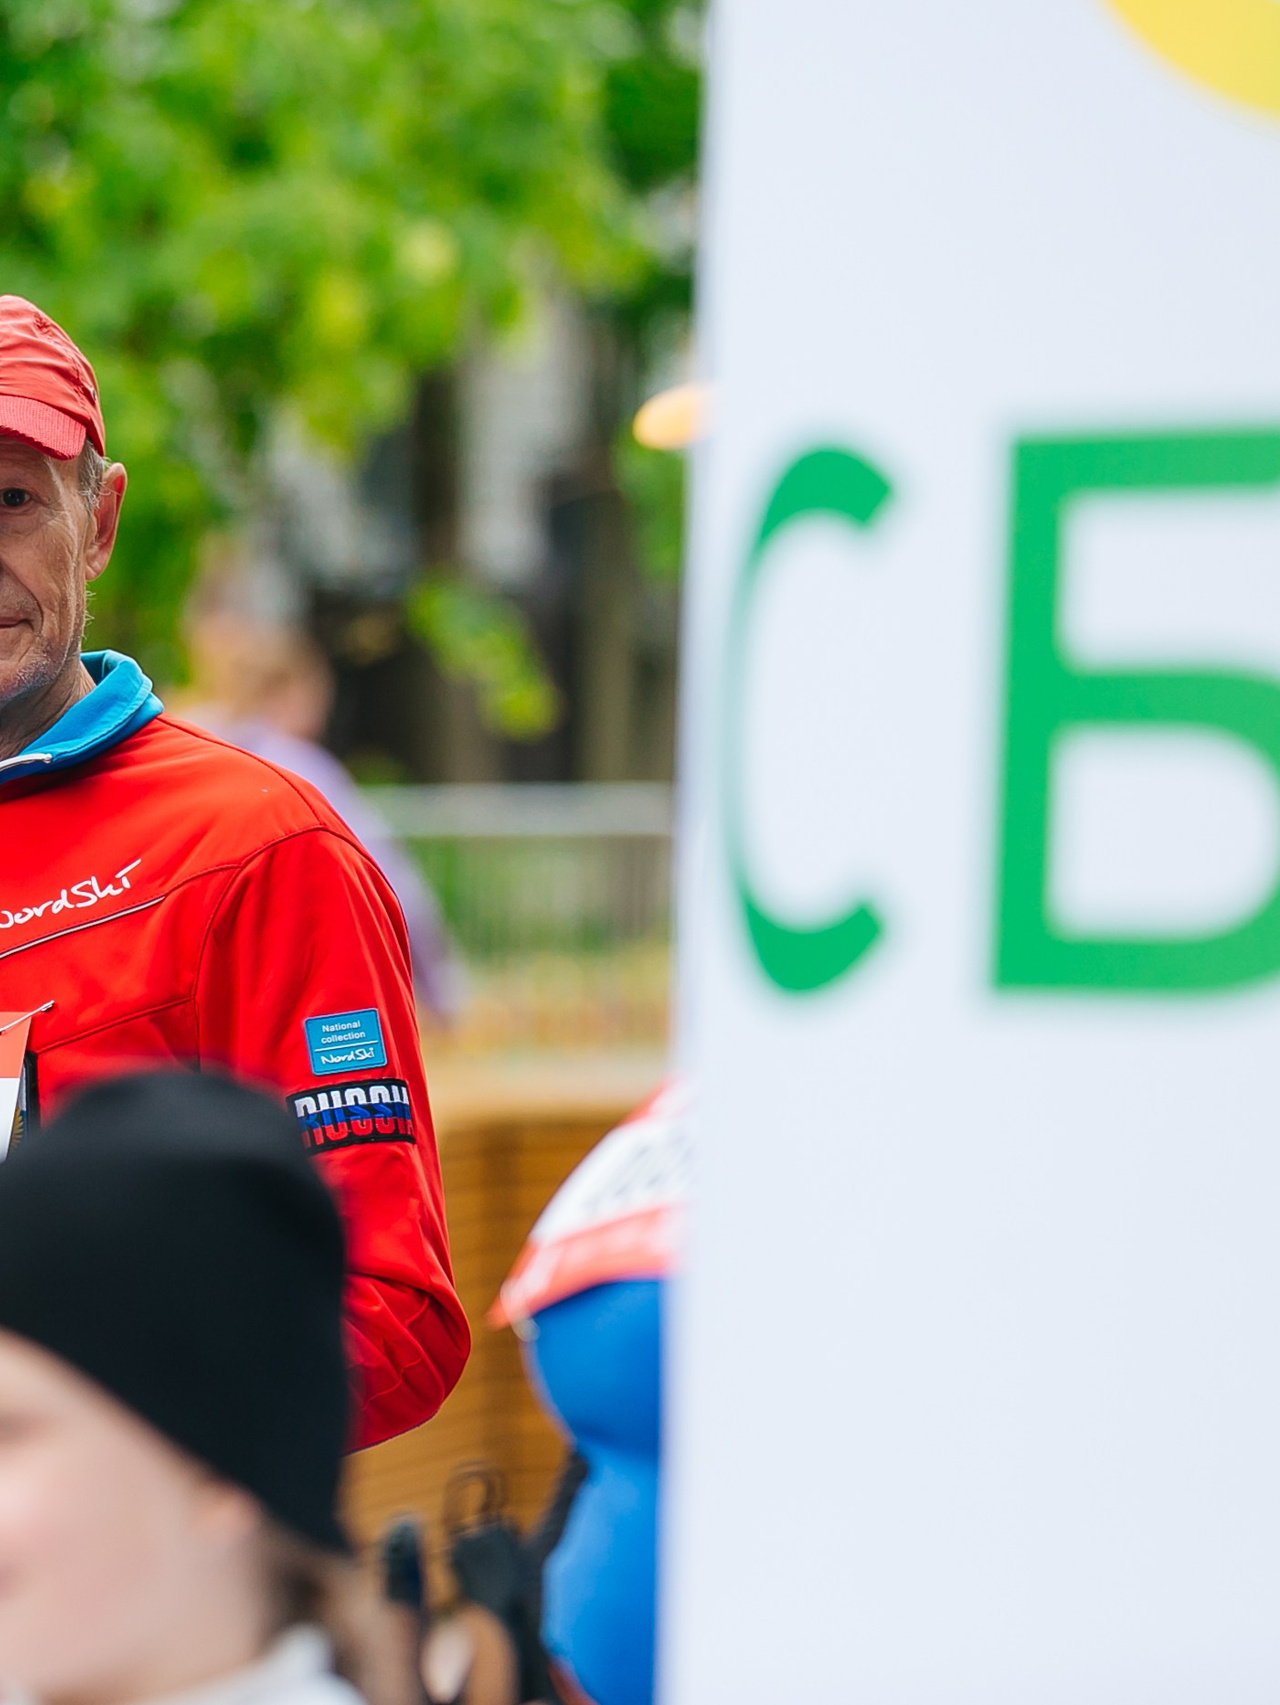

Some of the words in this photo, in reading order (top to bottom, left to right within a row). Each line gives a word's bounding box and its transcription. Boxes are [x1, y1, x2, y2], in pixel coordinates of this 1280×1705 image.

[322, 1020, 361, 1033] National
[320, 1031, 366, 1045] collection
[320, 1047, 375, 1065] NordSki
